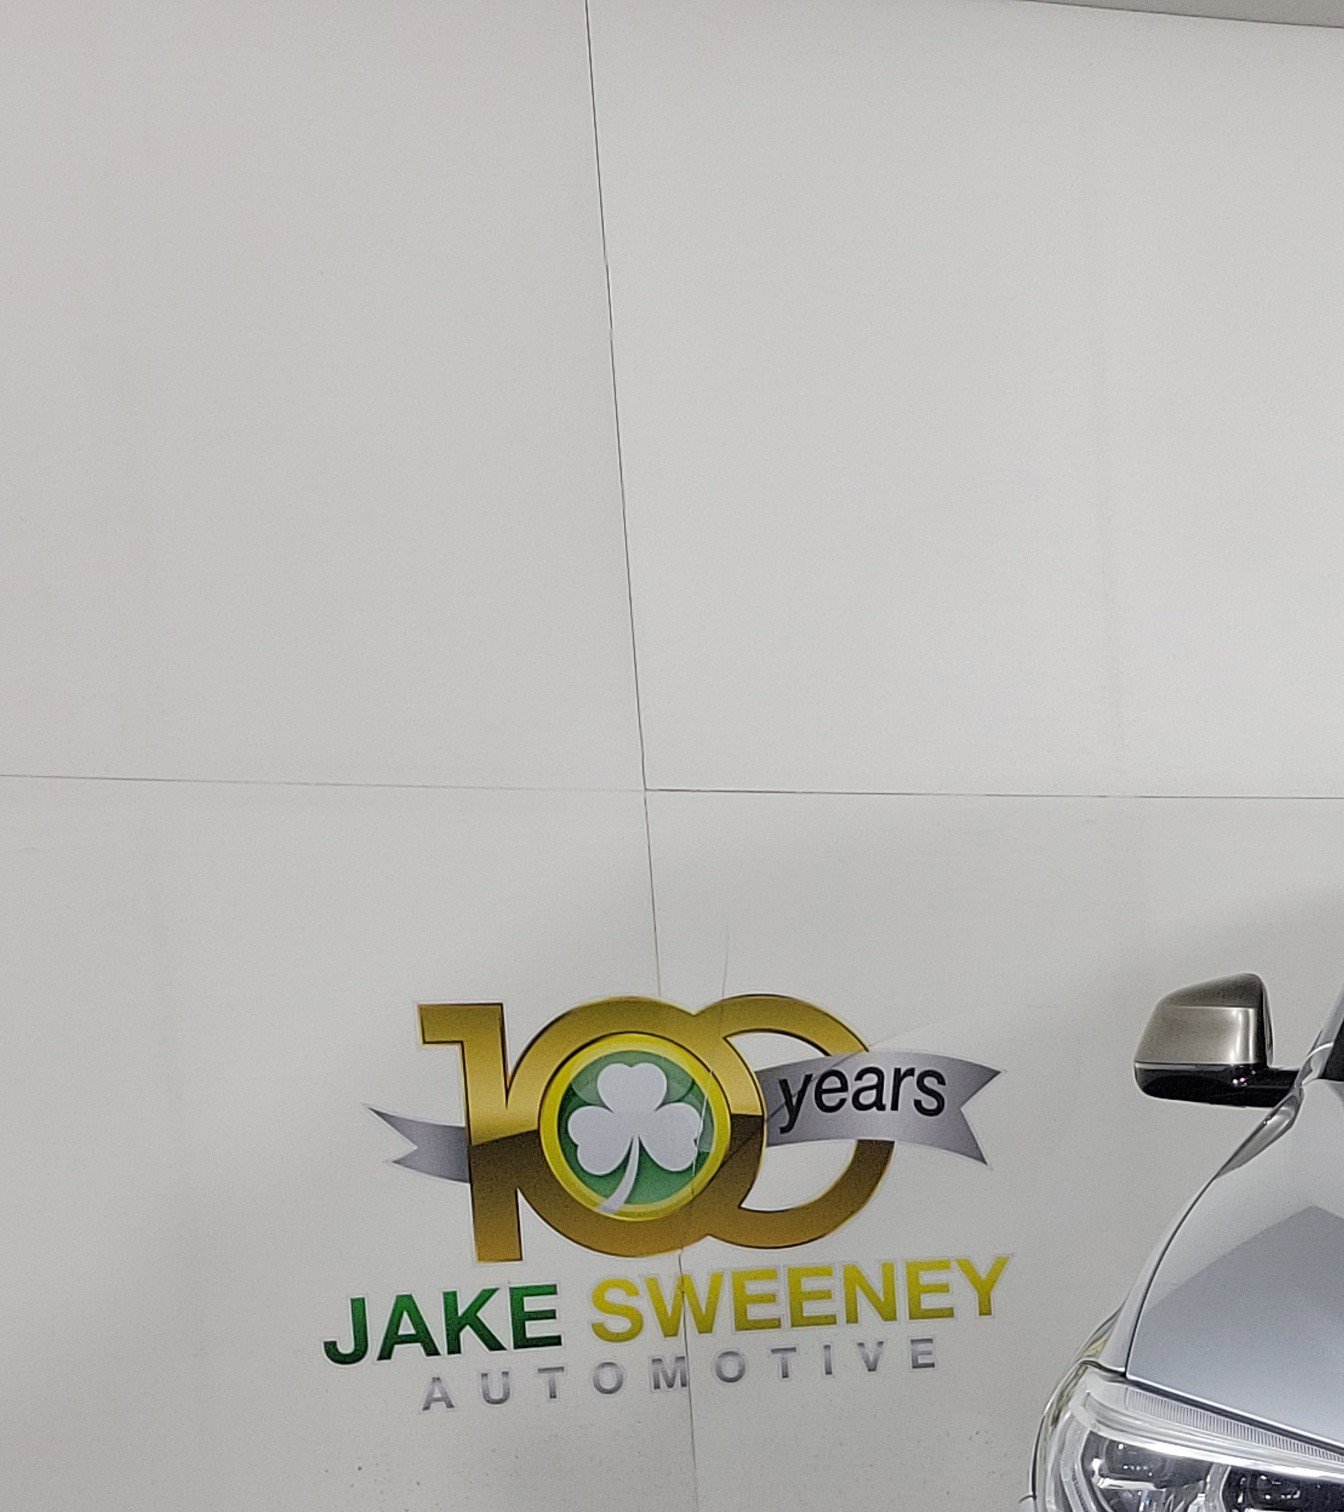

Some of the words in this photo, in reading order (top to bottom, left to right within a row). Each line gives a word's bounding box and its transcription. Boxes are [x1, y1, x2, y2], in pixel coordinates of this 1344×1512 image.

[778, 1065, 947, 1134] years
[322, 1283, 564, 1366] JAKE
[589, 1255, 1011, 1344] SWEENEY
[420, 1338, 937, 1412] AUTOMOTIVE
